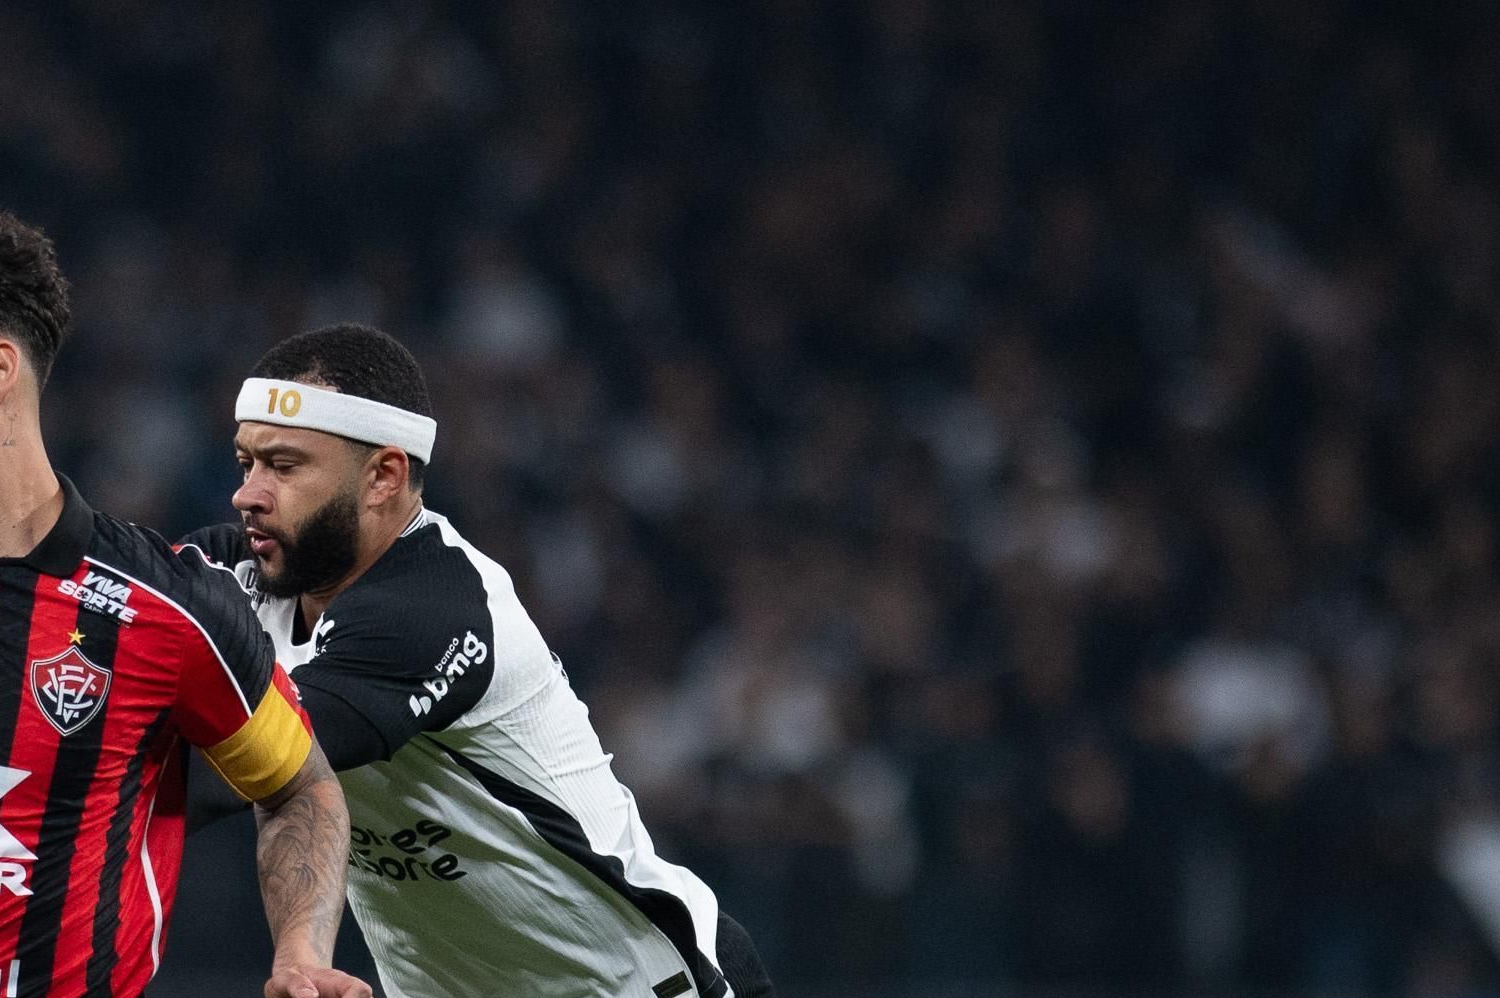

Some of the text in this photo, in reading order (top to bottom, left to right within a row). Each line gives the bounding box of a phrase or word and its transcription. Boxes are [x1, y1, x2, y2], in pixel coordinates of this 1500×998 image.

[267, 388, 302, 418] 10
[57, 579, 139, 624] SORTE
[82, 571, 133, 604] VIVA
[422, 630, 488, 702] bmg
[434, 637, 460, 673] banco
